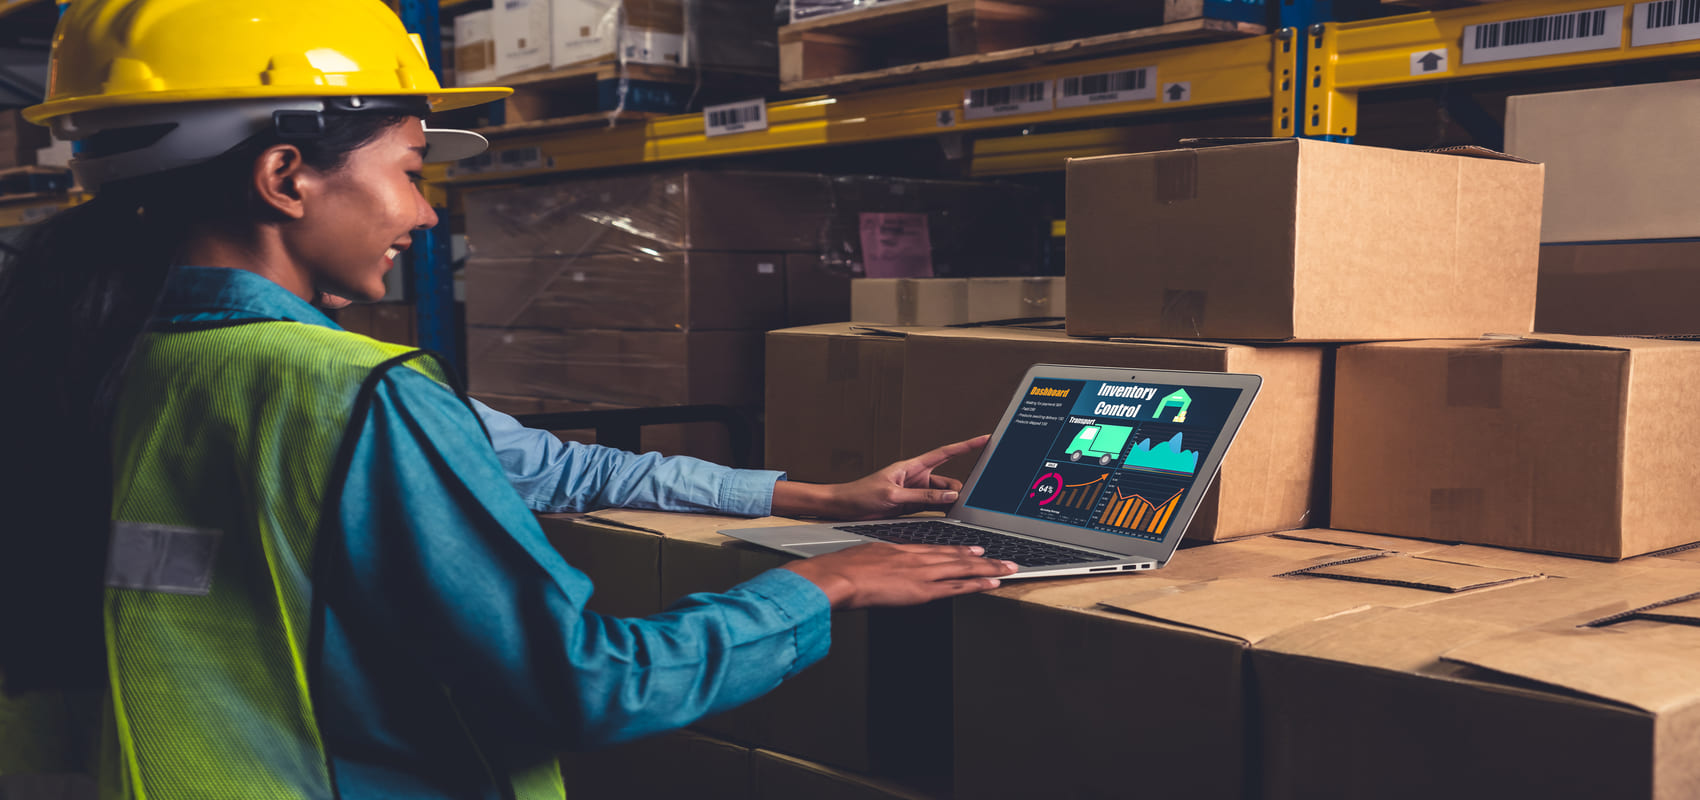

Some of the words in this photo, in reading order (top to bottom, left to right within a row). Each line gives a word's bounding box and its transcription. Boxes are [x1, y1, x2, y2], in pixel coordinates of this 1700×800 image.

[1030, 386, 1070, 398] Dashboard
[1097, 382, 1158, 401] Inventory
[1094, 401, 1142, 418] Control
[1069, 416, 1096, 425] Transport
[1038, 484, 1054, 494] 64%
